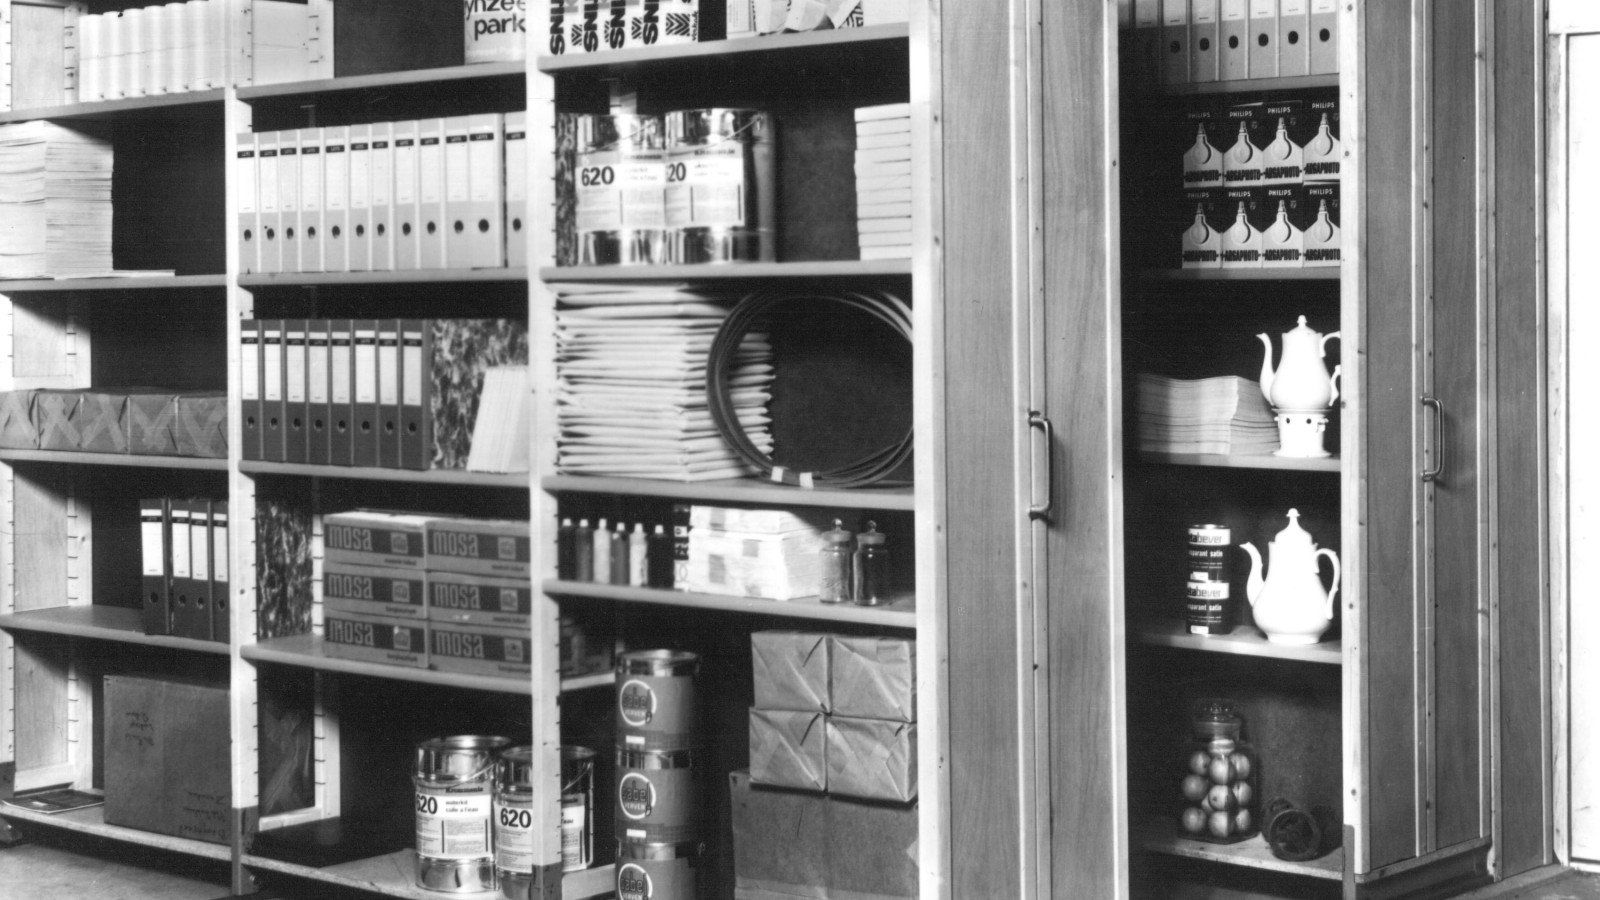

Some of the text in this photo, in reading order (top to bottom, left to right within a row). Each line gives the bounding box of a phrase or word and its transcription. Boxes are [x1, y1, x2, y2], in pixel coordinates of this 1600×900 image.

[475, 13, 526, 41] park
[581, 166, 615, 187] 620
[500, 808, 532, 828] 620
